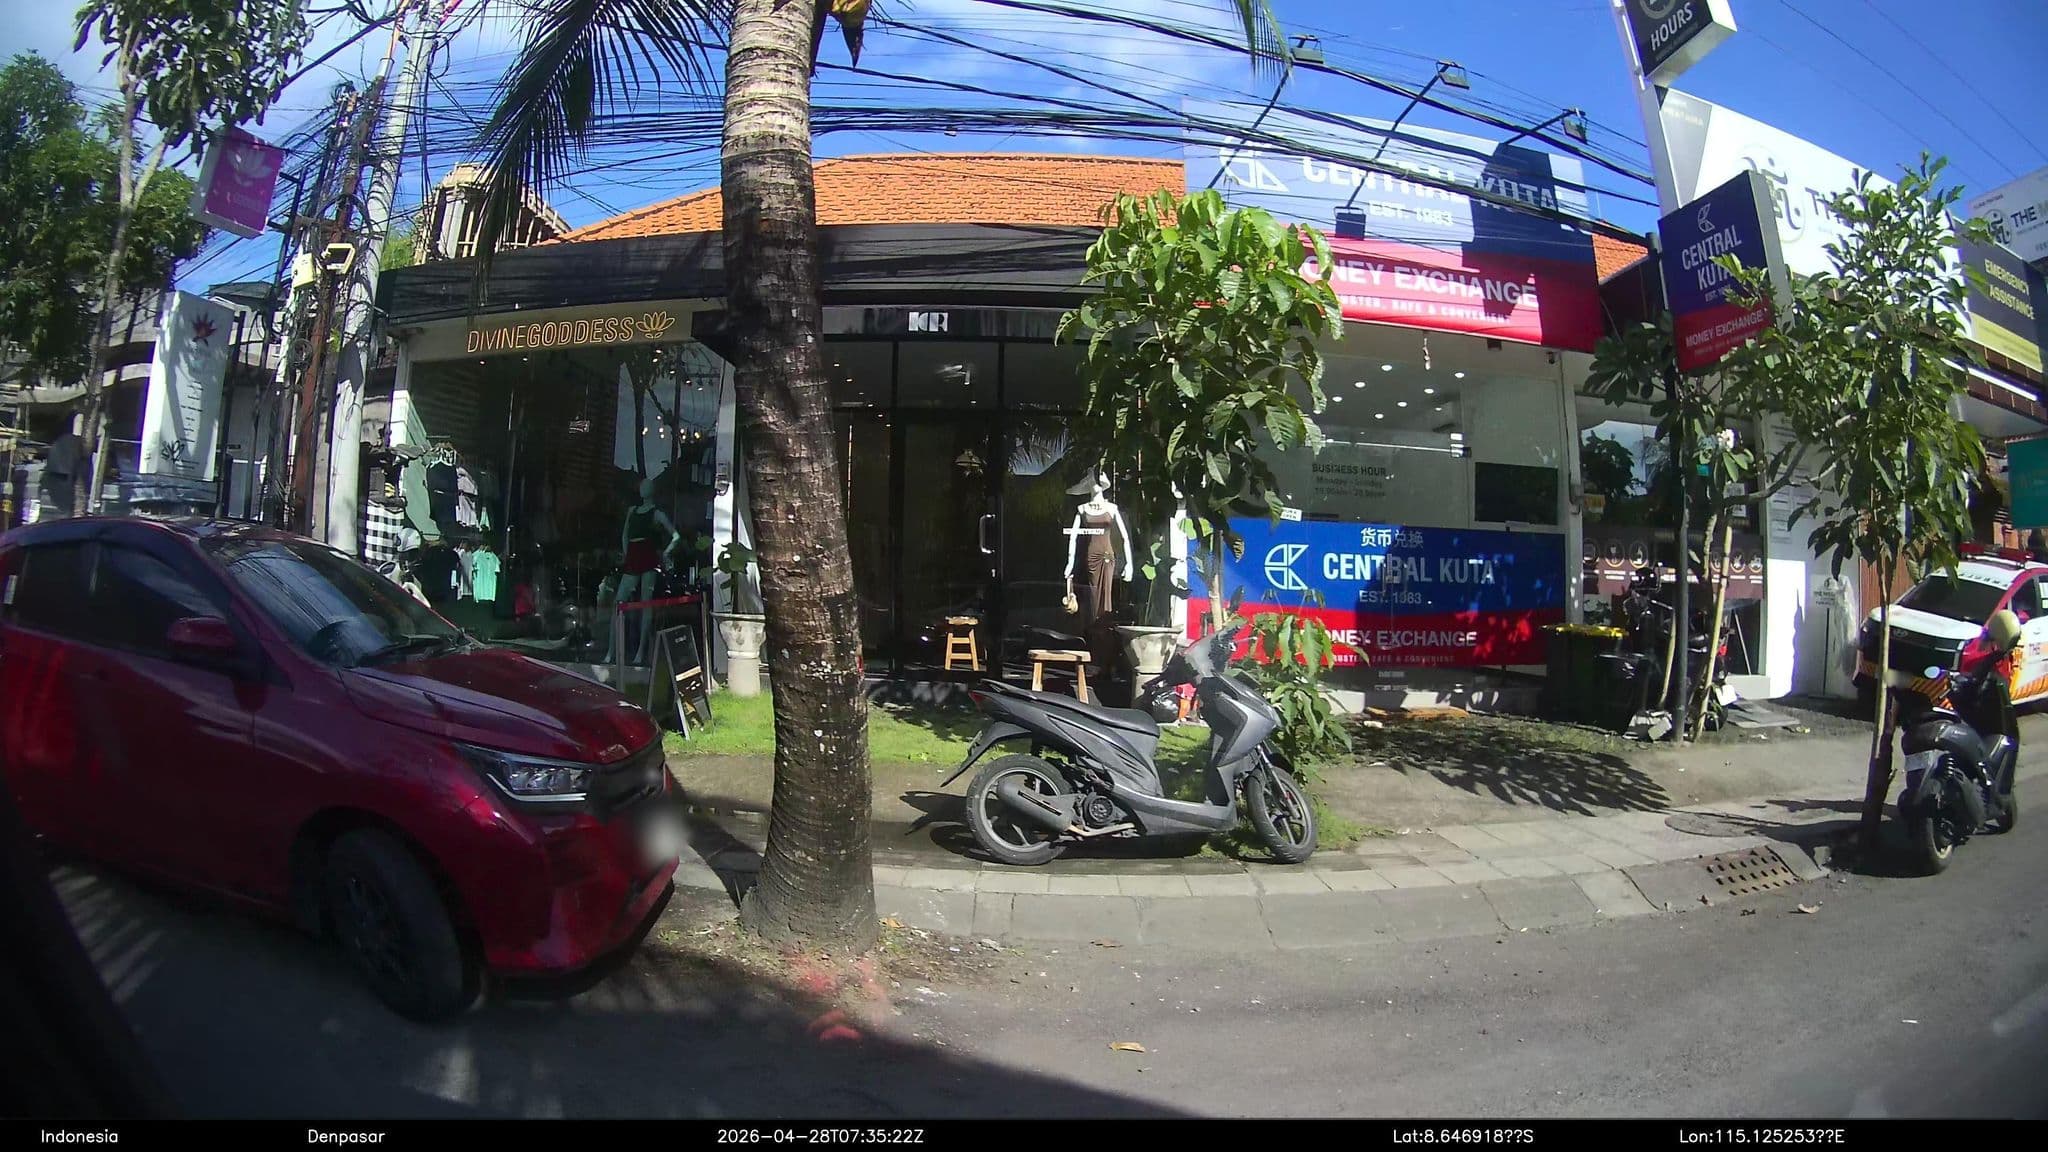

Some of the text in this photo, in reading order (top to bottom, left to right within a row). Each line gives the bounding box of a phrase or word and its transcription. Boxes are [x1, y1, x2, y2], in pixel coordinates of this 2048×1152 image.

[1651, 2, 1693, 51] HOURS
[2010, 206, 2038, 228] THE
[1681, 225, 1743, 270] CENTRAL
[1300, 255, 1539, 308] ONEY EXCHANGE
[1985, 258, 2029, 296] EMERGENCY
[1990, 284, 2035, 319] ASSISTANCE
[1685, 326, 1715, 348] MONEY
[1715, 310, 1763, 337] EXCHANGE
[1312, 463, 1358, 475] BUSINESS
[1360, 527, 1424, 548] 货币兑换
[1323, 552, 1496, 585] CENTRAL KUTA
[1376, 630, 1478, 648] EXCHANGE
